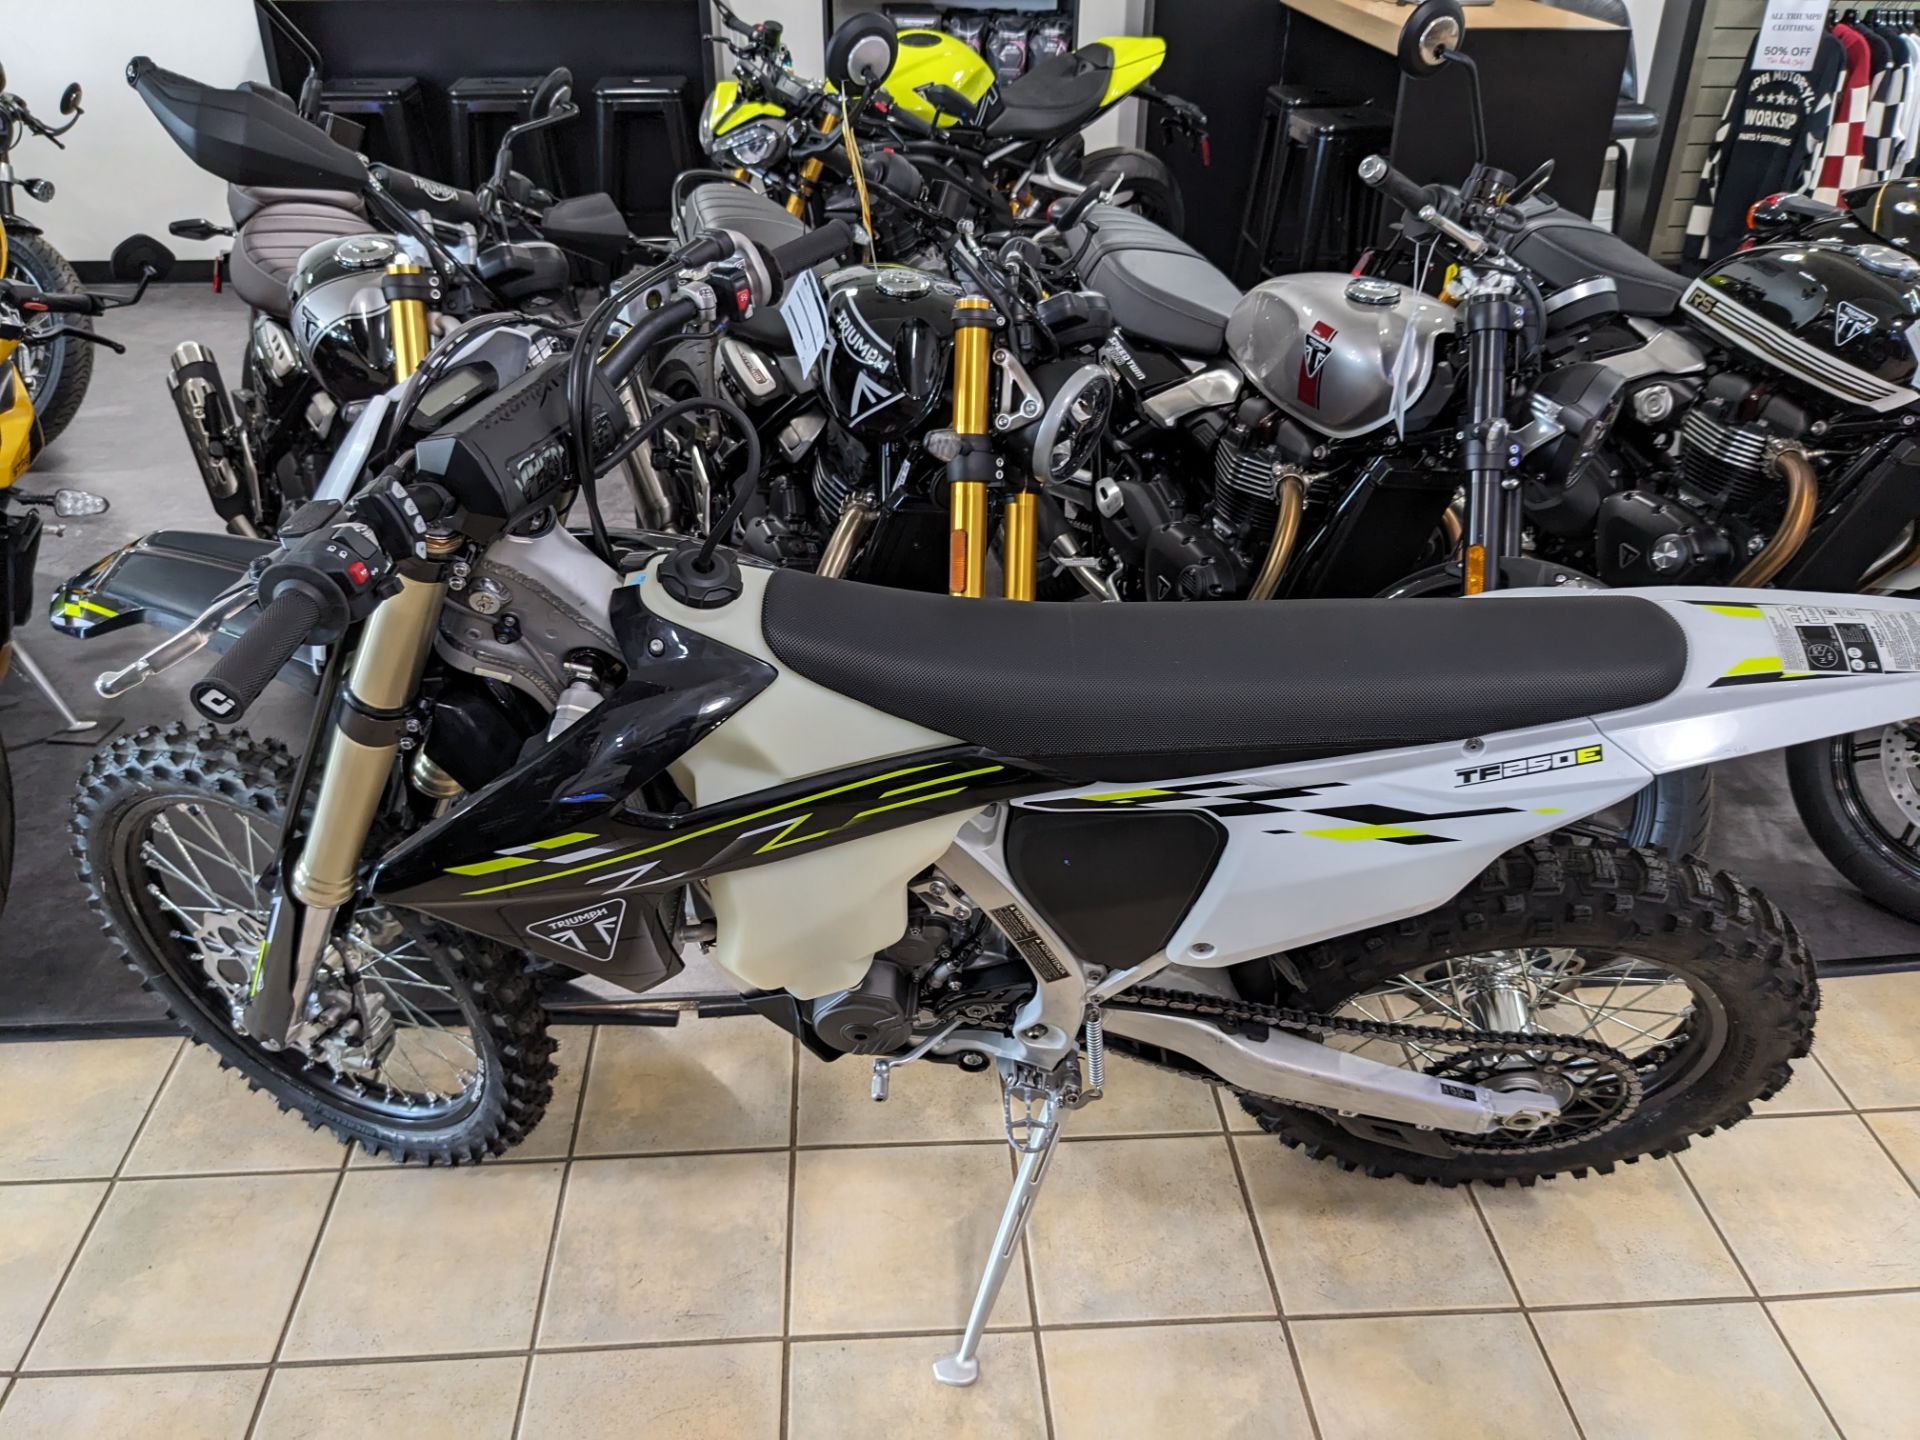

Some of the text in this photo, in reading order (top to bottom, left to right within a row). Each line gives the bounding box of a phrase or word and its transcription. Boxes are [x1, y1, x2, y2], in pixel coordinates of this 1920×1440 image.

[1772, 24, 1816, 32] CLOTHING
[1763, 46, 1812, 57] 50% OFF
[1689, 289, 1715, 313] RS
[835, 308, 891, 375] TRIUMPH
[1107, 336, 1131, 361] SPEED
[1454, 744, 1603, 787] TF250E
[548, 907, 609, 931] TRIUMPH
